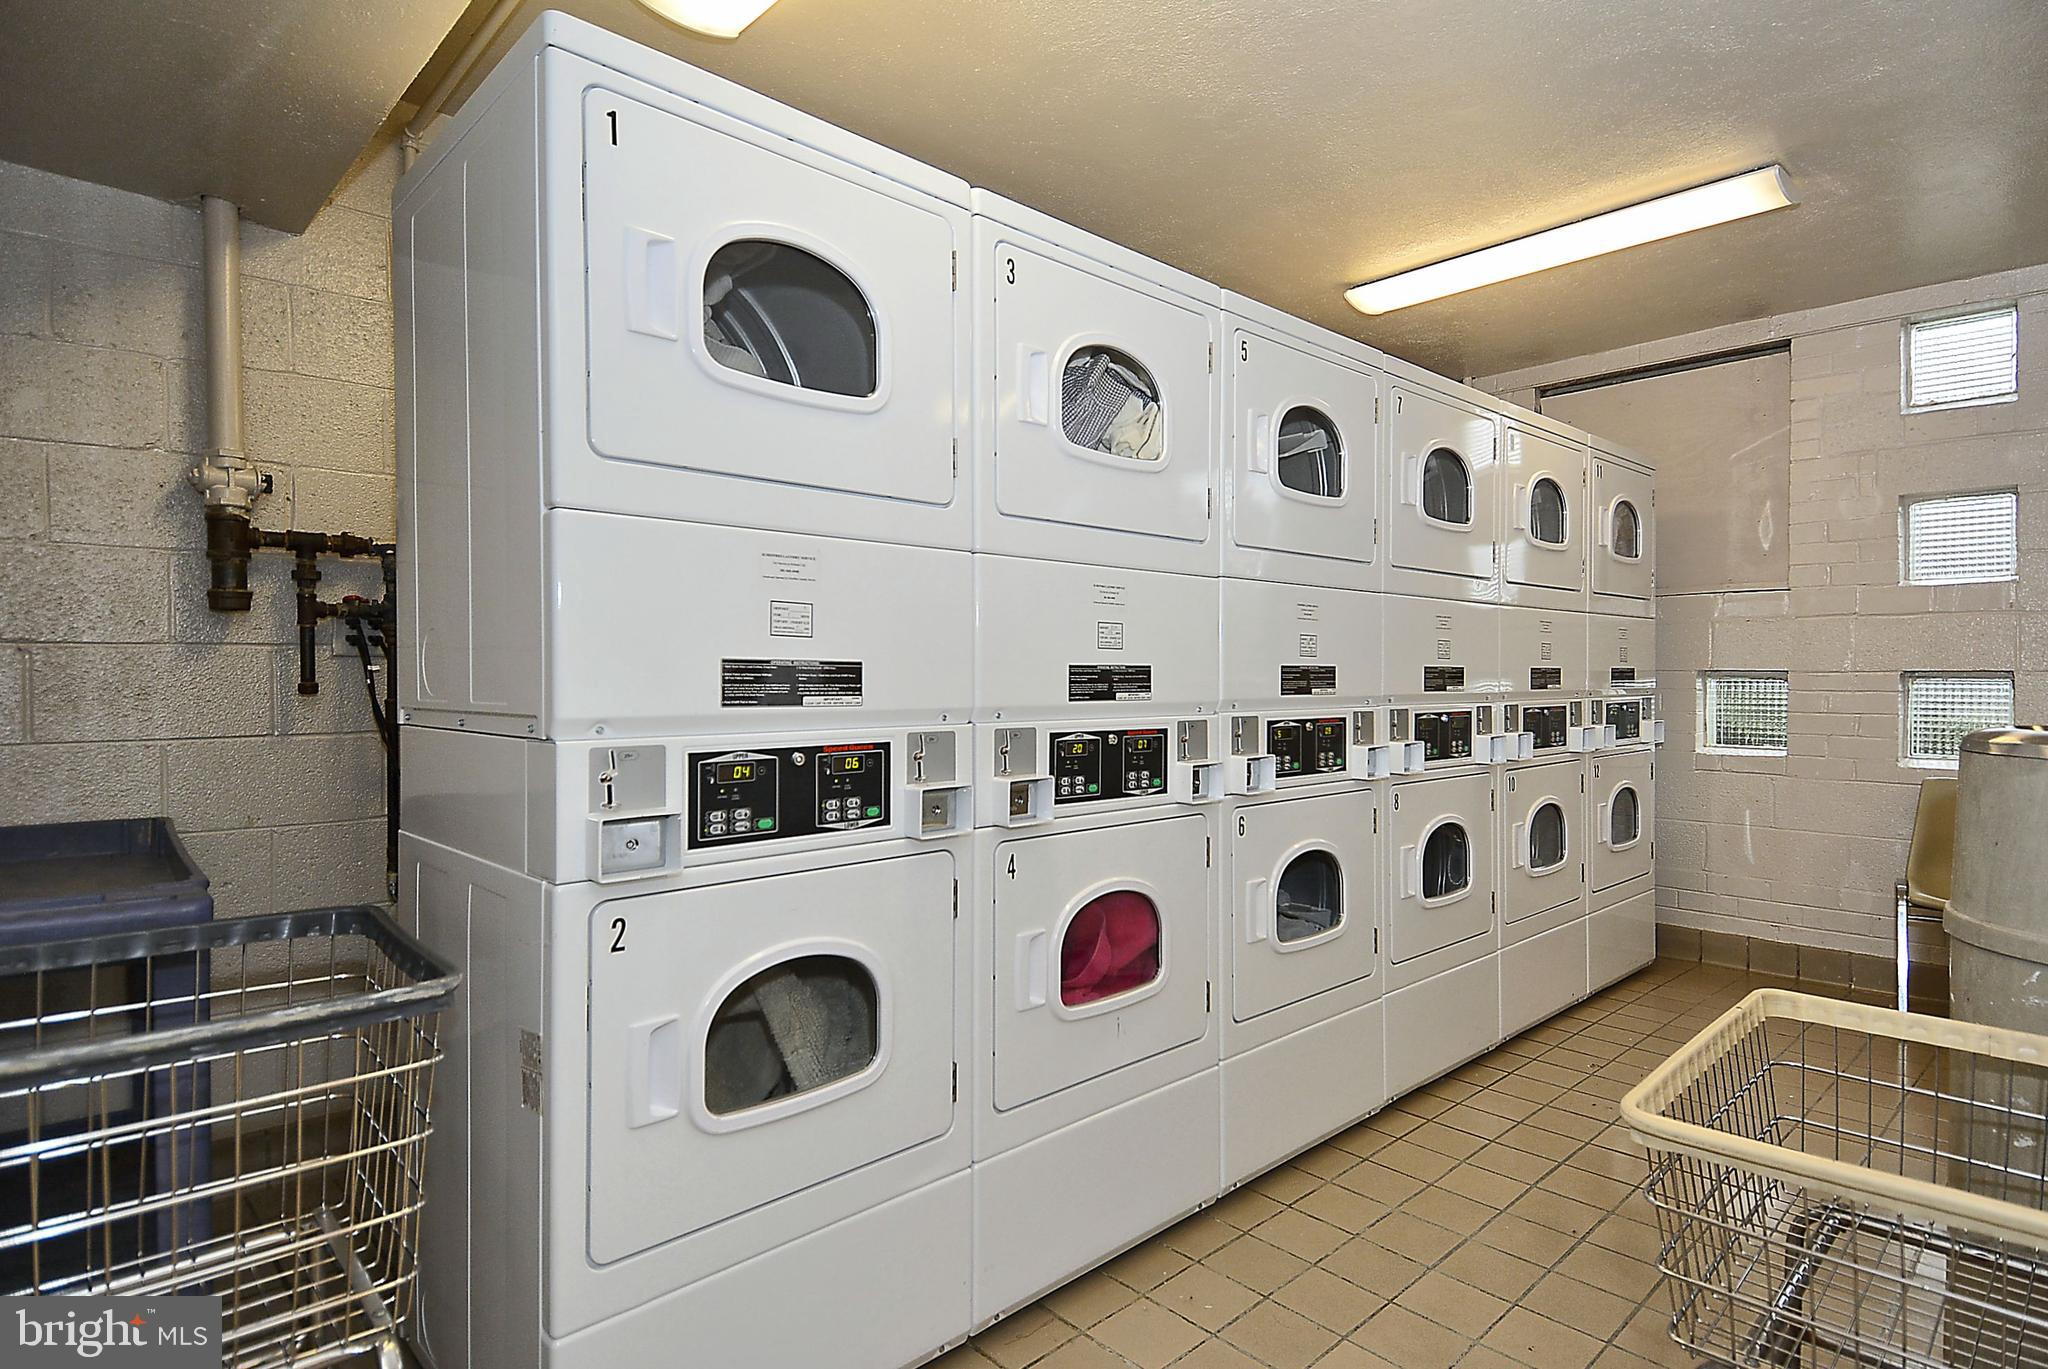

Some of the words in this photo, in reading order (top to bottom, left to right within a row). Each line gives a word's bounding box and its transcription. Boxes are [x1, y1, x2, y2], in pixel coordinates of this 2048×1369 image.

[606, 110, 618, 146] 1
[1006, 258, 1015, 285] 3
[1241, 340, 1248, 362] 5
[1397, 396, 1403, 414] 7
[1072, 743, 1083, 754] 20
[733, 766, 750, 779] 04
[845, 757, 859, 770] 06
[1593, 764, 1600, 778] 12
[1508, 776, 1516, 792] 10
[1394, 793, 1399, 810] 8
[1238, 815, 1245, 836] 6
[1007, 853, 1016, 880] 4
[611, 917, 626, 953] 2
